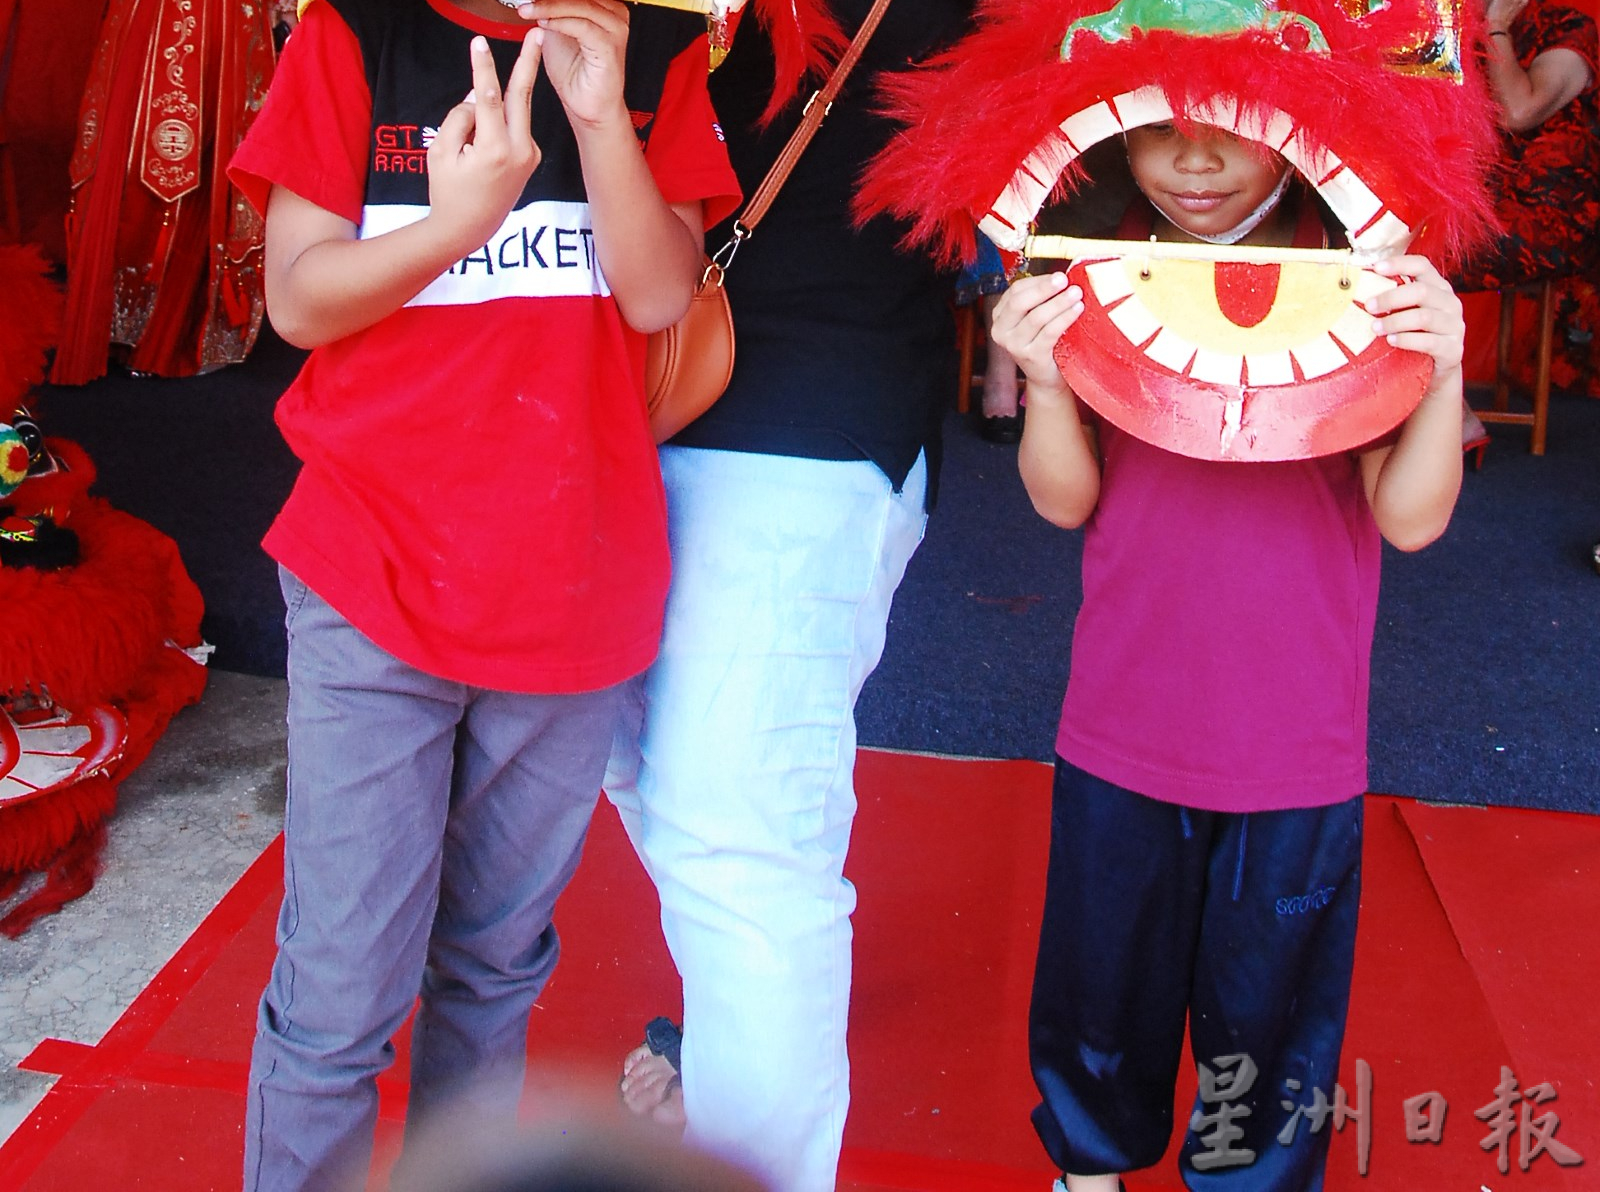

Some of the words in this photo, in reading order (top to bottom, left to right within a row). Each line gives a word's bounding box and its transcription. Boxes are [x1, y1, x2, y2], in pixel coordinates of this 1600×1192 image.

[375, 125, 418, 149] GT
[375, 153, 425, 174] RACI
[448, 225, 593, 275] ACKET
